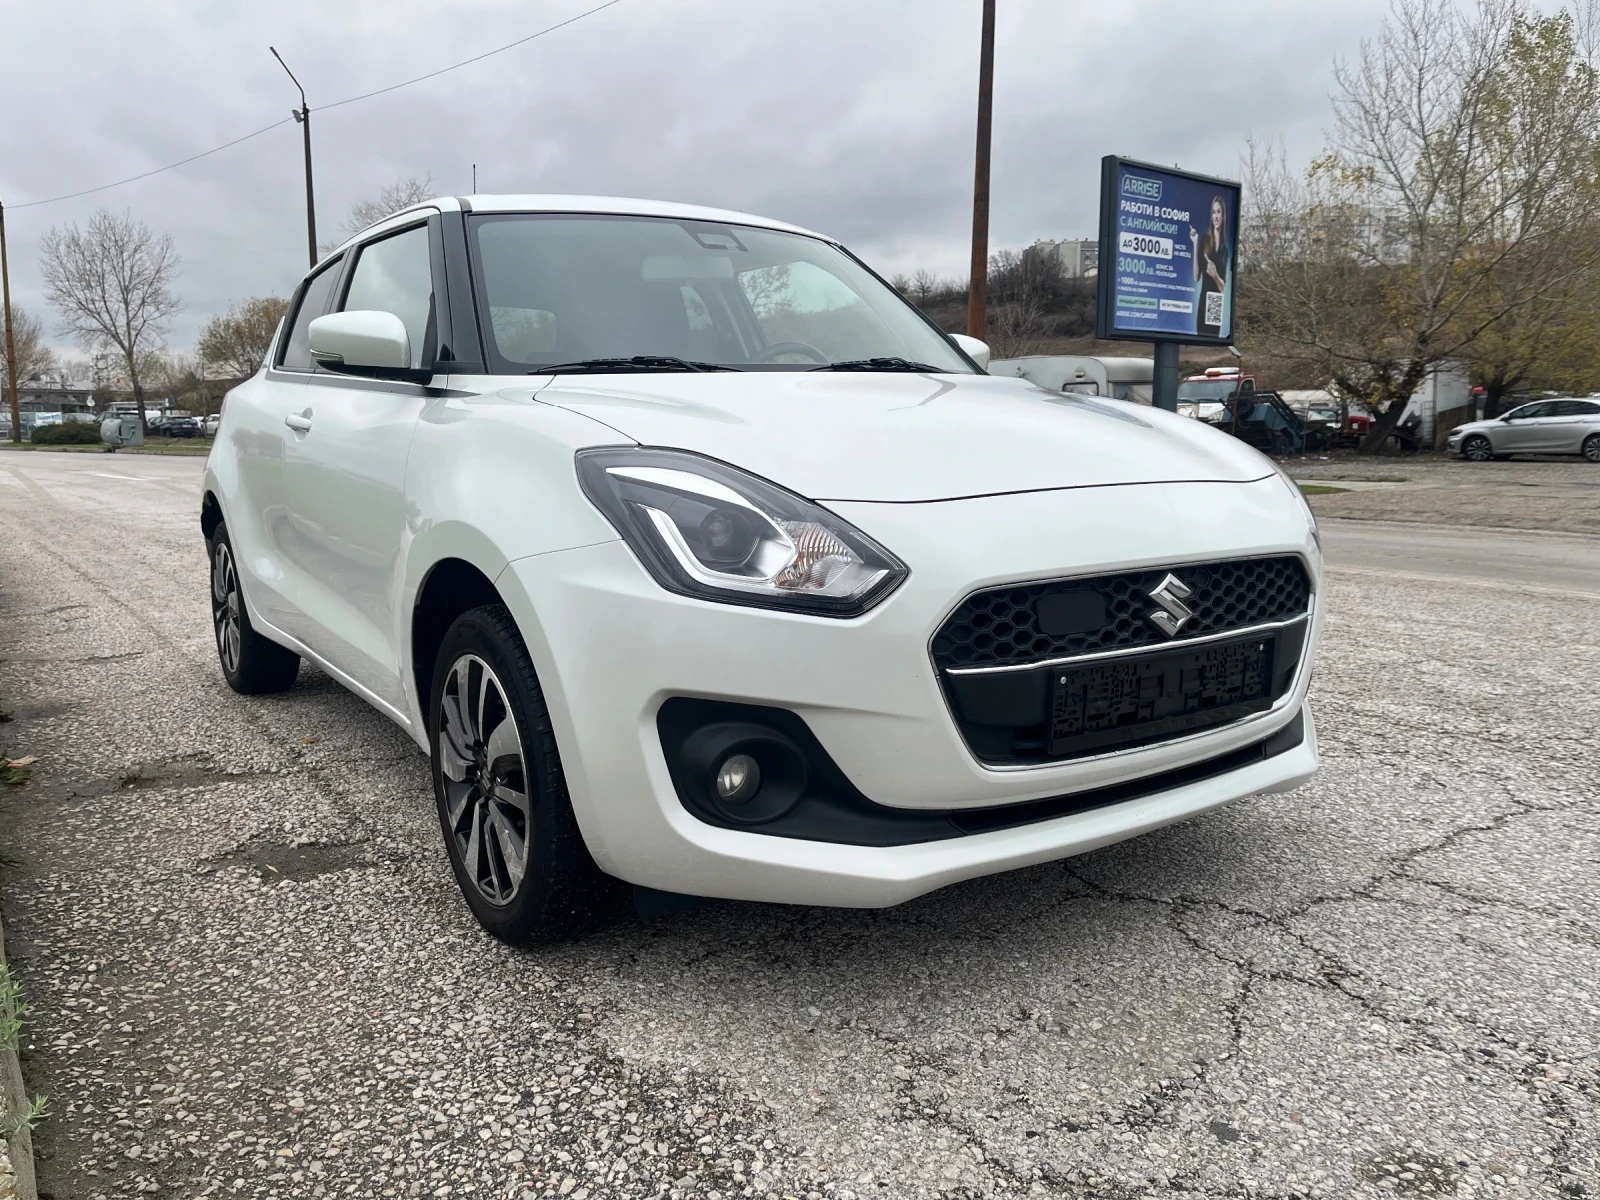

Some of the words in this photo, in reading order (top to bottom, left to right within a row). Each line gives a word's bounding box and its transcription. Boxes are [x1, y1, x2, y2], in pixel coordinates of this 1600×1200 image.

[1124, 179, 1160, 197] ARRISE
[1121, 200, 1153, 215] РАБОТИ
[1154, 206, 1160, 217] В
[1161, 207, 1189, 222] СОФИЯ
[1120, 215, 1126, 227] С
[1127, 217, 1177, 234] АНГЛИЙСКИ!
